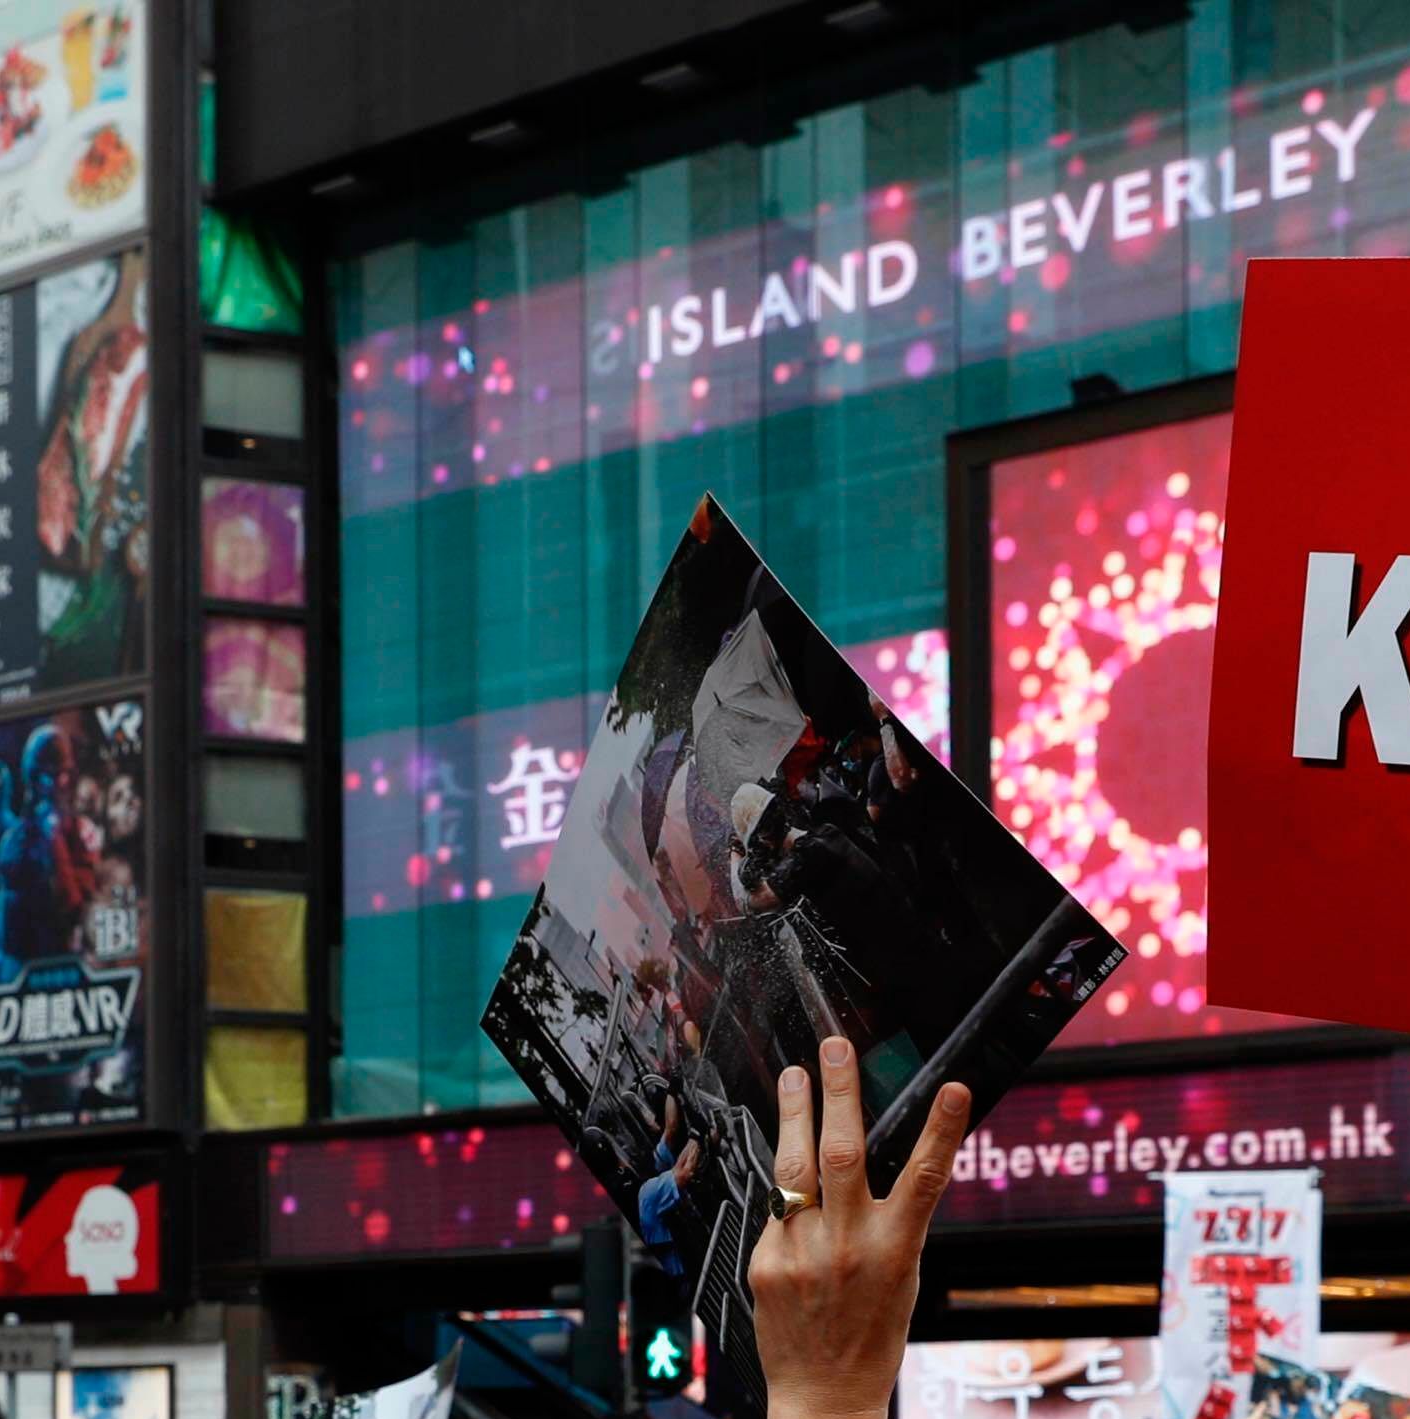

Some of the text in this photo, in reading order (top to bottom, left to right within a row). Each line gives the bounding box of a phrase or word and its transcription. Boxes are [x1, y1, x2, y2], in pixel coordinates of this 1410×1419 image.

[647, 107, 1378, 364] ISLAND BEVERLEY
[488, 743, 579, 850] 金
[950, 1102, 1395, 1183] dbeverley.com.hk
